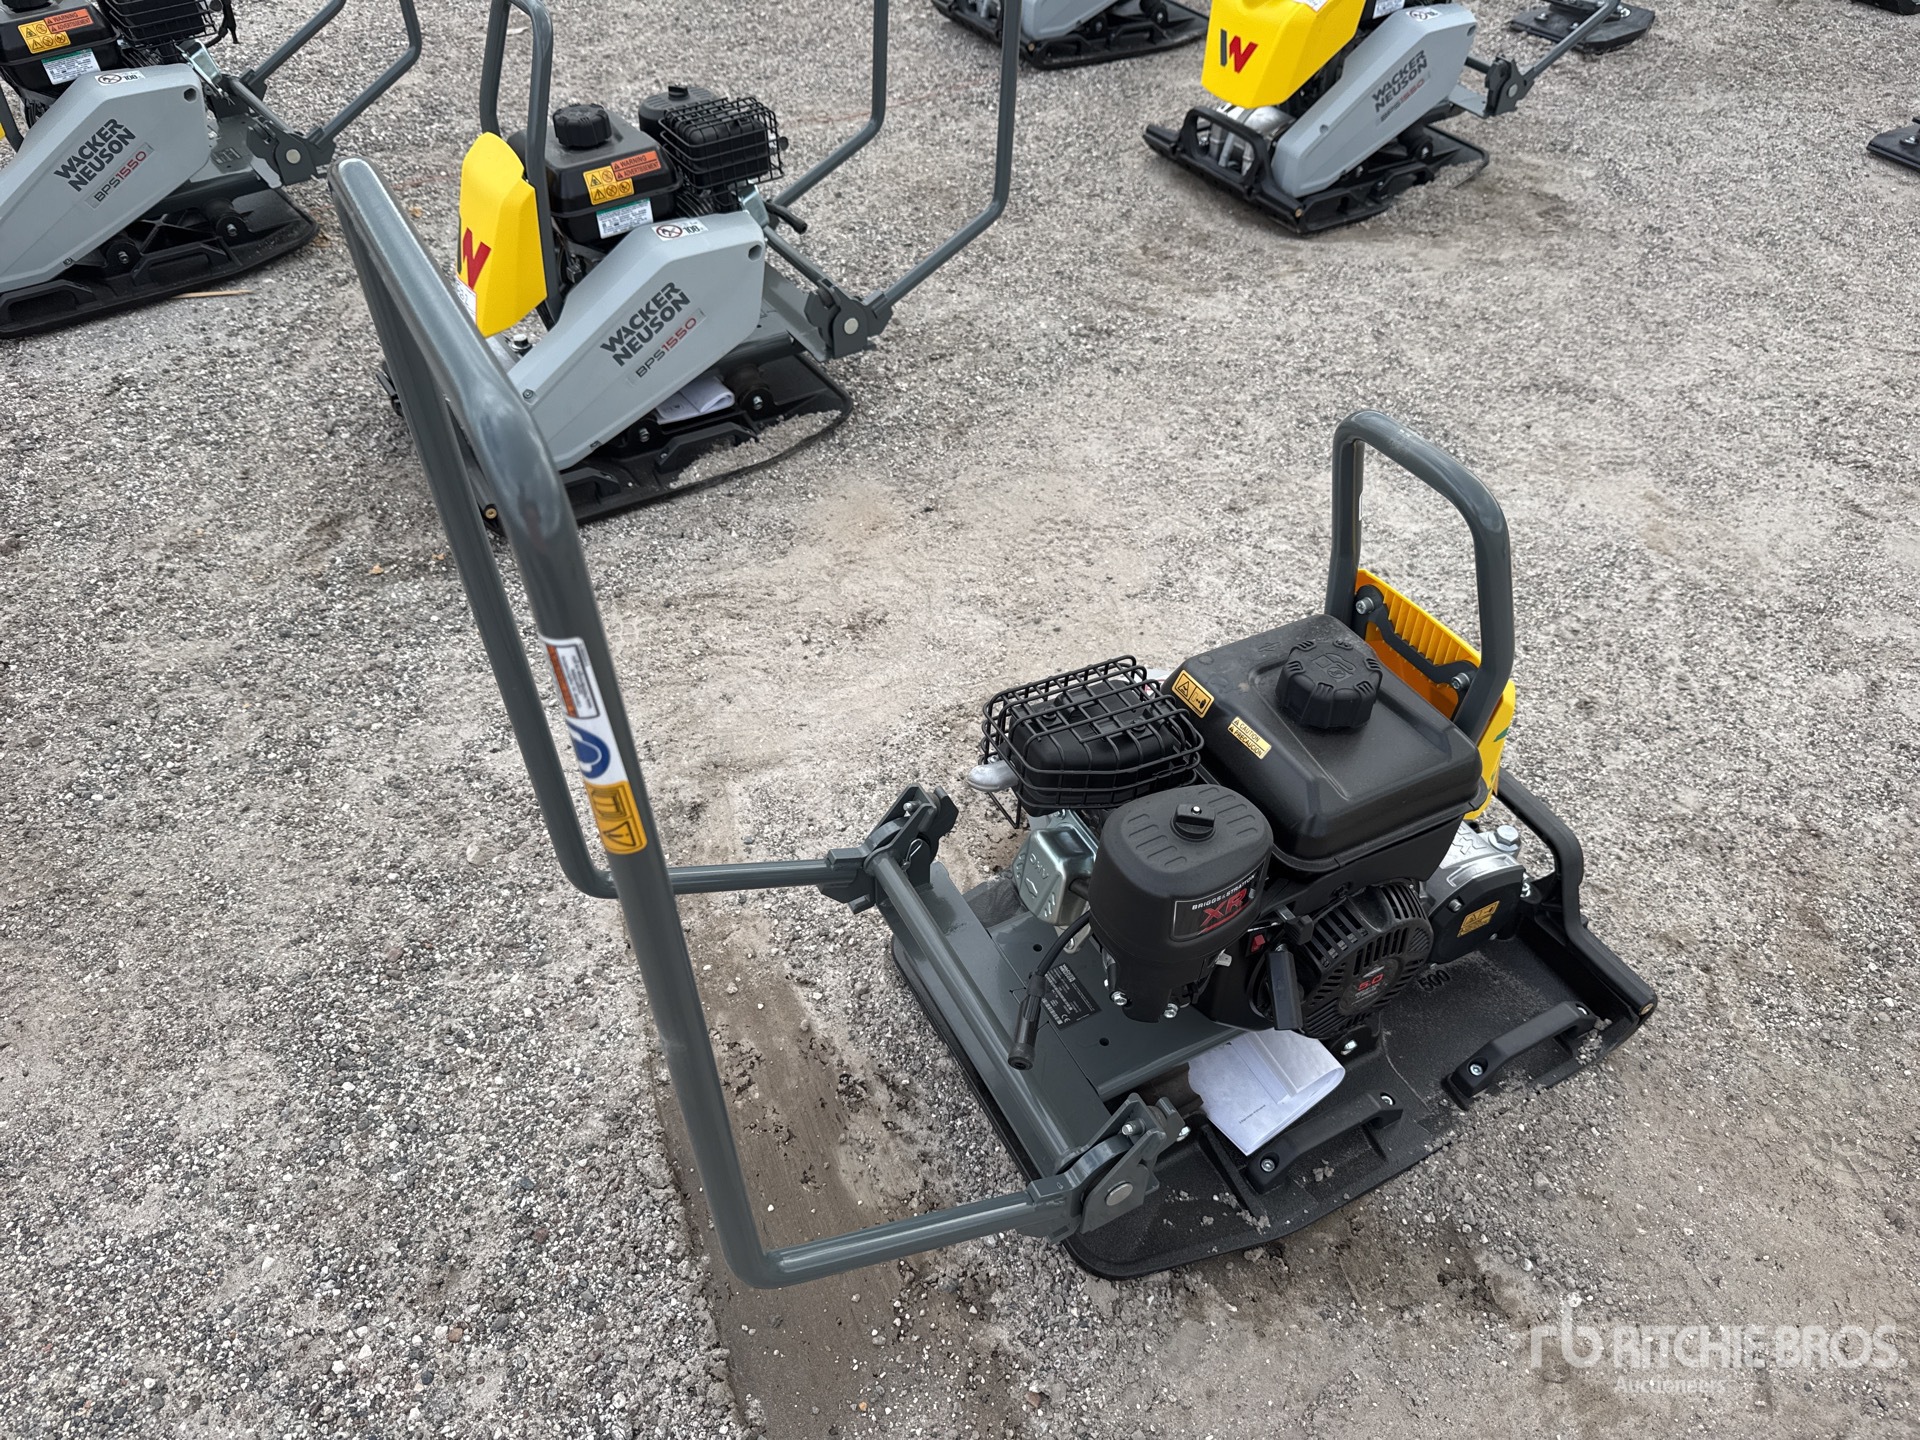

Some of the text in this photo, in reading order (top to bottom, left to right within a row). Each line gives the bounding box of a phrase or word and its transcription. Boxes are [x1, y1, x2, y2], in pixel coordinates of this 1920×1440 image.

[53, 12, 79, 22] WARNING
[1372, 50, 1426, 101] WACKER
[1375, 59, 1428, 113] NEUSON
[53, 119, 124, 179] WACKER
[68, 127, 136, 192] NEUSON
[620, 155, 647, 167] WARNING
[94, 151, 147, 202] BPS1550
[600, 282, 682, 353] WACKER
[612, 291, 691, 367] NEUSON
[635, 317, 697, 378] BPS1550
[1239, 722, 1261, 742] CAUTION
[1200, 888, 1248, 928] XR
[1357, 973, 1384, 992] 5.0
